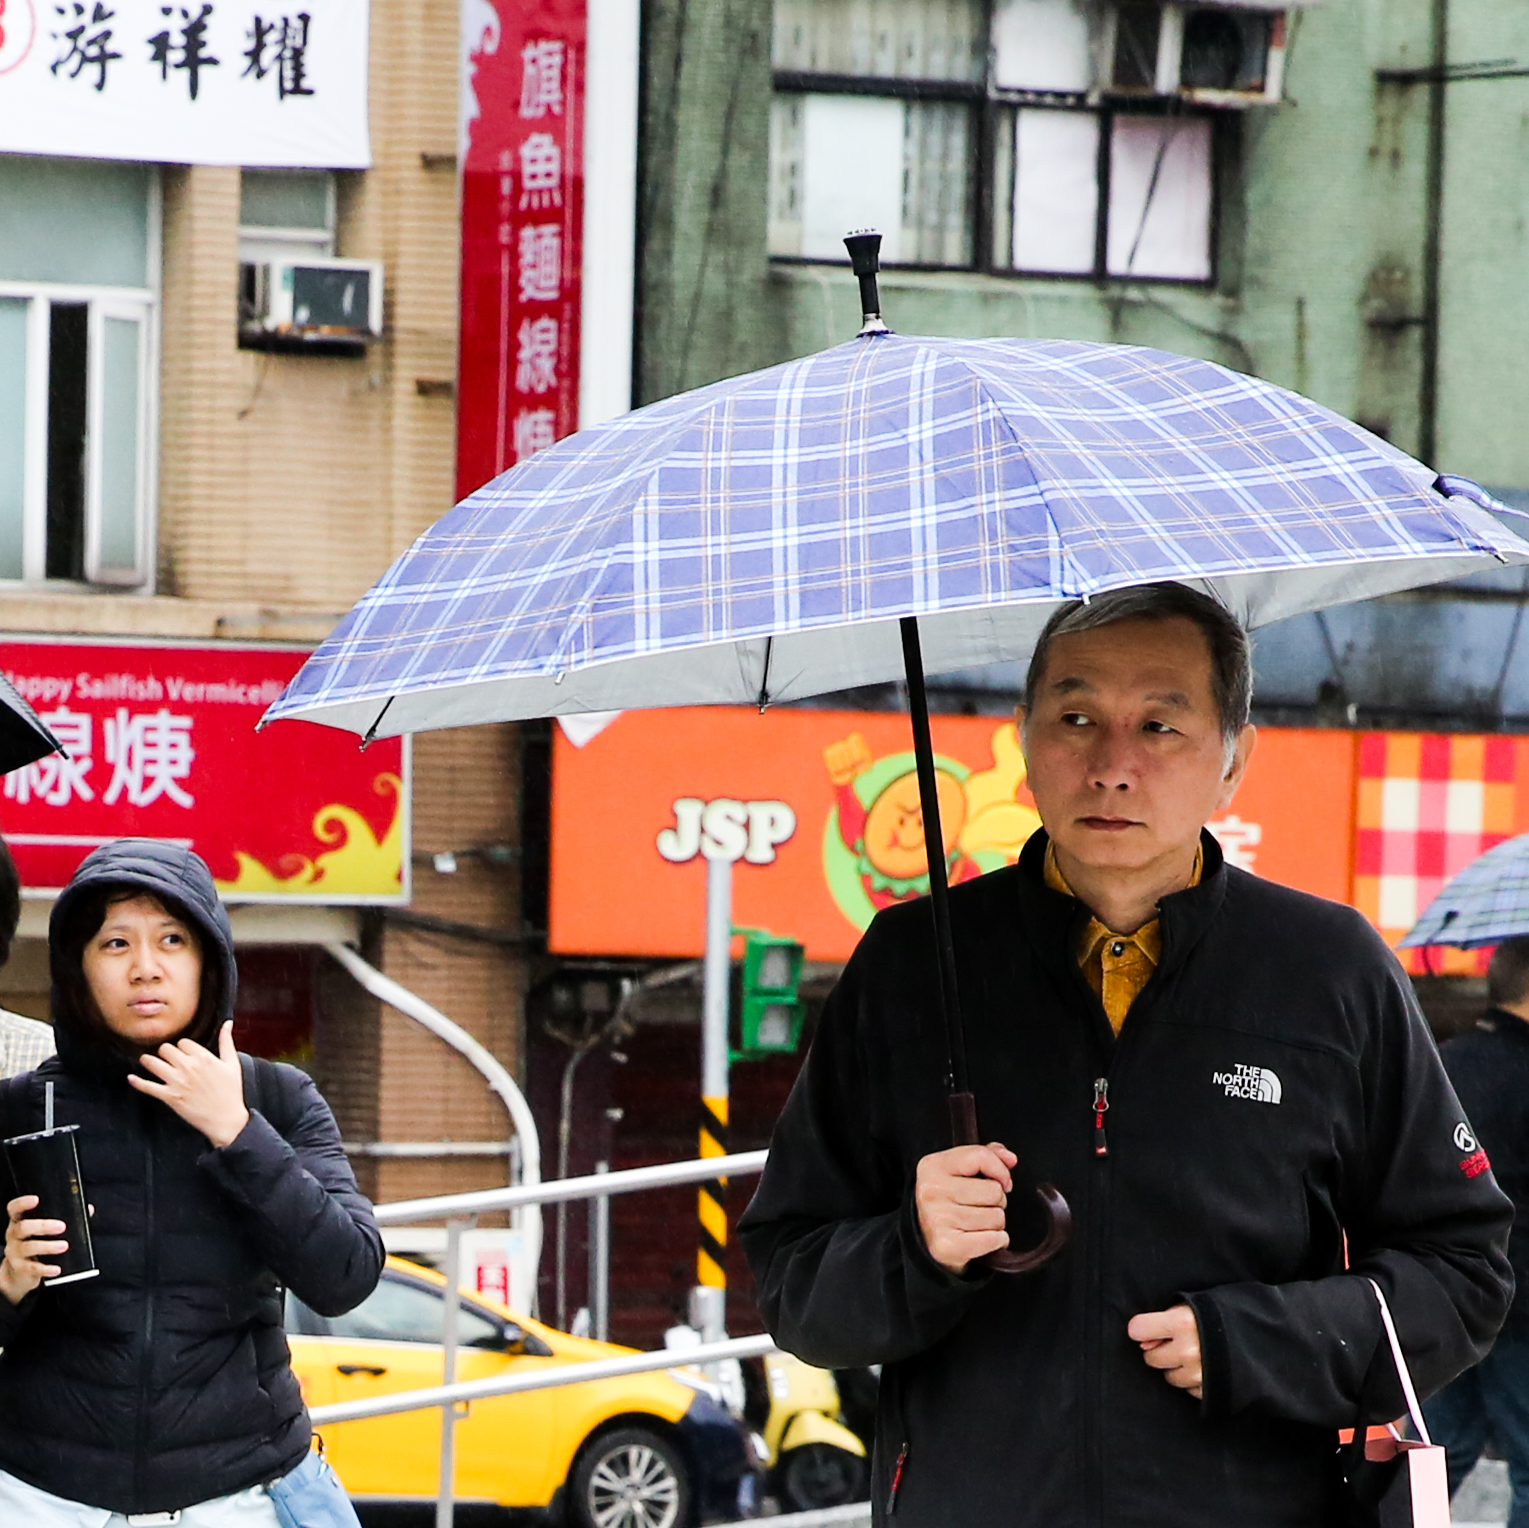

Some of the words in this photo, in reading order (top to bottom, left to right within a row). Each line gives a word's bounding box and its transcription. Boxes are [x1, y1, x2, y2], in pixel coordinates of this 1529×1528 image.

[49, 2, 315, 101] 游祥耀
[74, 671, 164, 701] Sailfish
[655, 797, 797, 865] JSP
[1212, 1071, 1260, 1090] NORTH
[1234, 1063, 1261, 1079] THE
[1224, 1084, 1259, 1101] FACE
